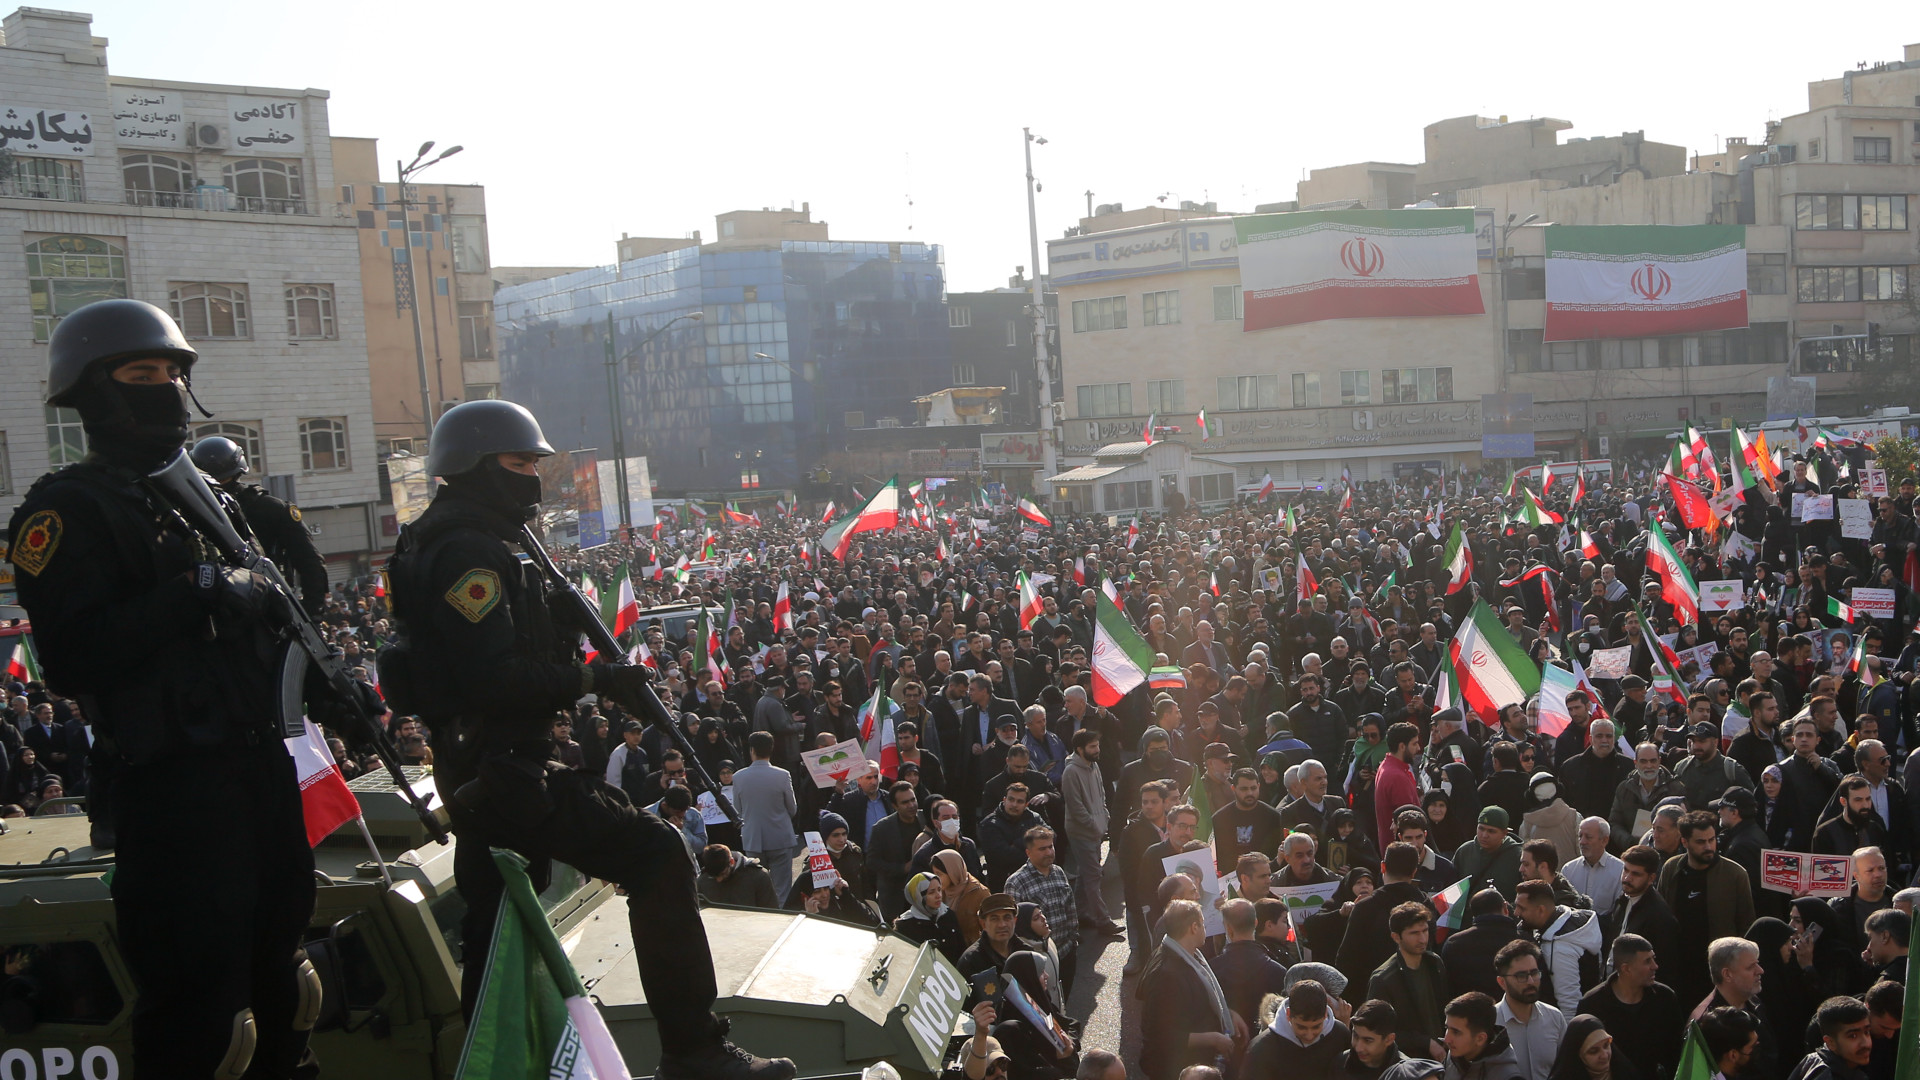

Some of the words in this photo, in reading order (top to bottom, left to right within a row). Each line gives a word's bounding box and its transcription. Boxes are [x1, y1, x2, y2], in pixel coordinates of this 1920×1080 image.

[126, 93, 166, 106] آموزش
[113, 110, 139, 121] دستی
[141, 112, 181, 124] الگوسازی
[234, 102, 297, 122] آکادمی
[170, 132, 177, 142] و
[237, 127, 296, 147] حنفی
[1377, 410, 1405, 429] ایران
[1881, 601, 1894, 609] مرگ
[813, 873, 829, 882] DOWN
[909, 961, 962, 1057] NOPO
[0, 1045, 119, 1080] OPO
